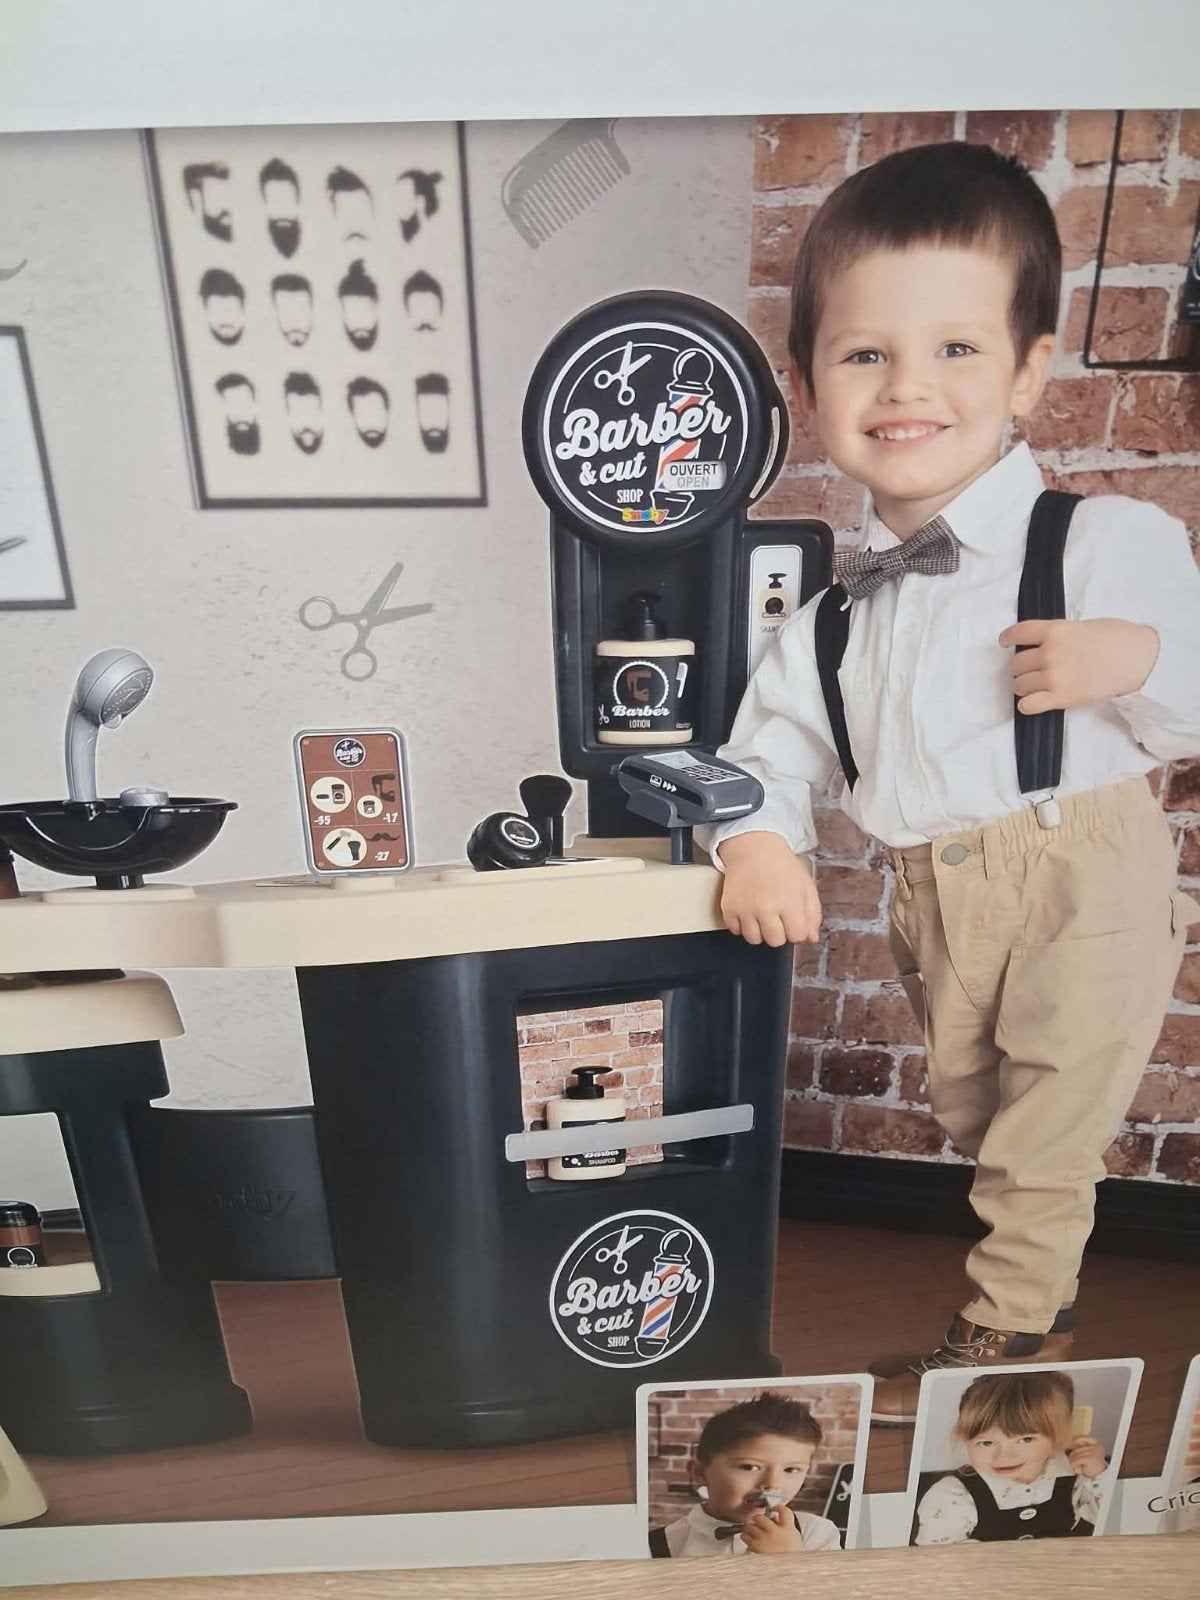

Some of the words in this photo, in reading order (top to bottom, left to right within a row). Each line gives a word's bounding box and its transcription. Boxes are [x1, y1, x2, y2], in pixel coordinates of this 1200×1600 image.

[555, 400, 732, 460] Barber
[578, 461, 597, 487] &
[599, 452, 648, 484] cut
[669, 463, 718, 476] OUVERT
[677, 476, 710, 489] OPEN
[616, 488, 644, 503] SHOP
[611, 705, 671, 717] Barber
[629, 719, 651, 728] LOTION
[558, 1268, 702, 1317] Barber
[576, 1317, 592, 1336] &
[594, 1308, 634, 1333] cut
[607, 1335, 630, 1348] SHOP
